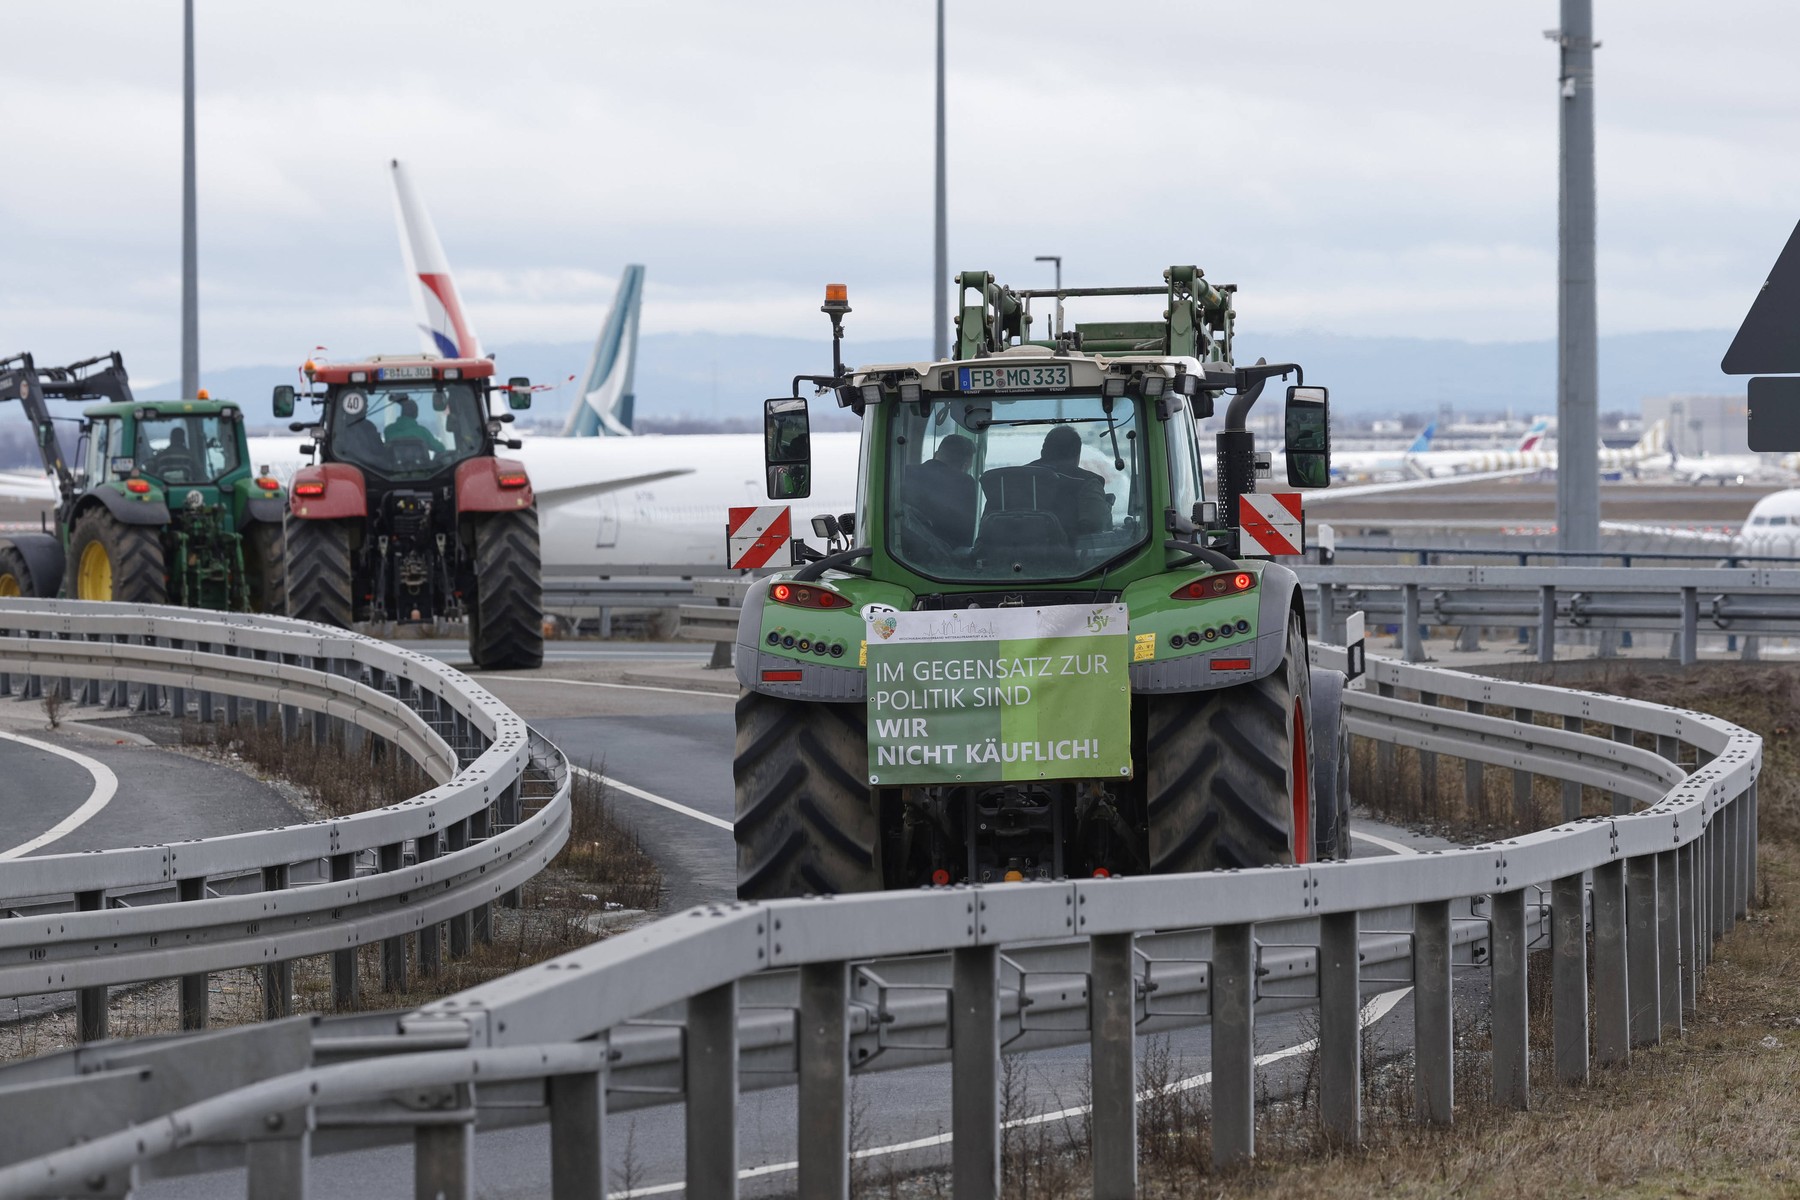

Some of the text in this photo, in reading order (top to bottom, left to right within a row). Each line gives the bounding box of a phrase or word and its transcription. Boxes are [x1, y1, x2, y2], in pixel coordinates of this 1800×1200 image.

[971, 370, 994, 387] FB
[1006, 369, 1030, 386] MQ
[1033, 368, 1066, 385] 333
[346, 396, 359, 410] 40
[876, 654, 1109, 683] IM GEGENSATZ ZUR
[877, 685, 1031, 710] POLITIK SIND
[876, 718, 928, 738] WIR
[877, 737, 1099, 766] NICHT KÄUFLICH!
